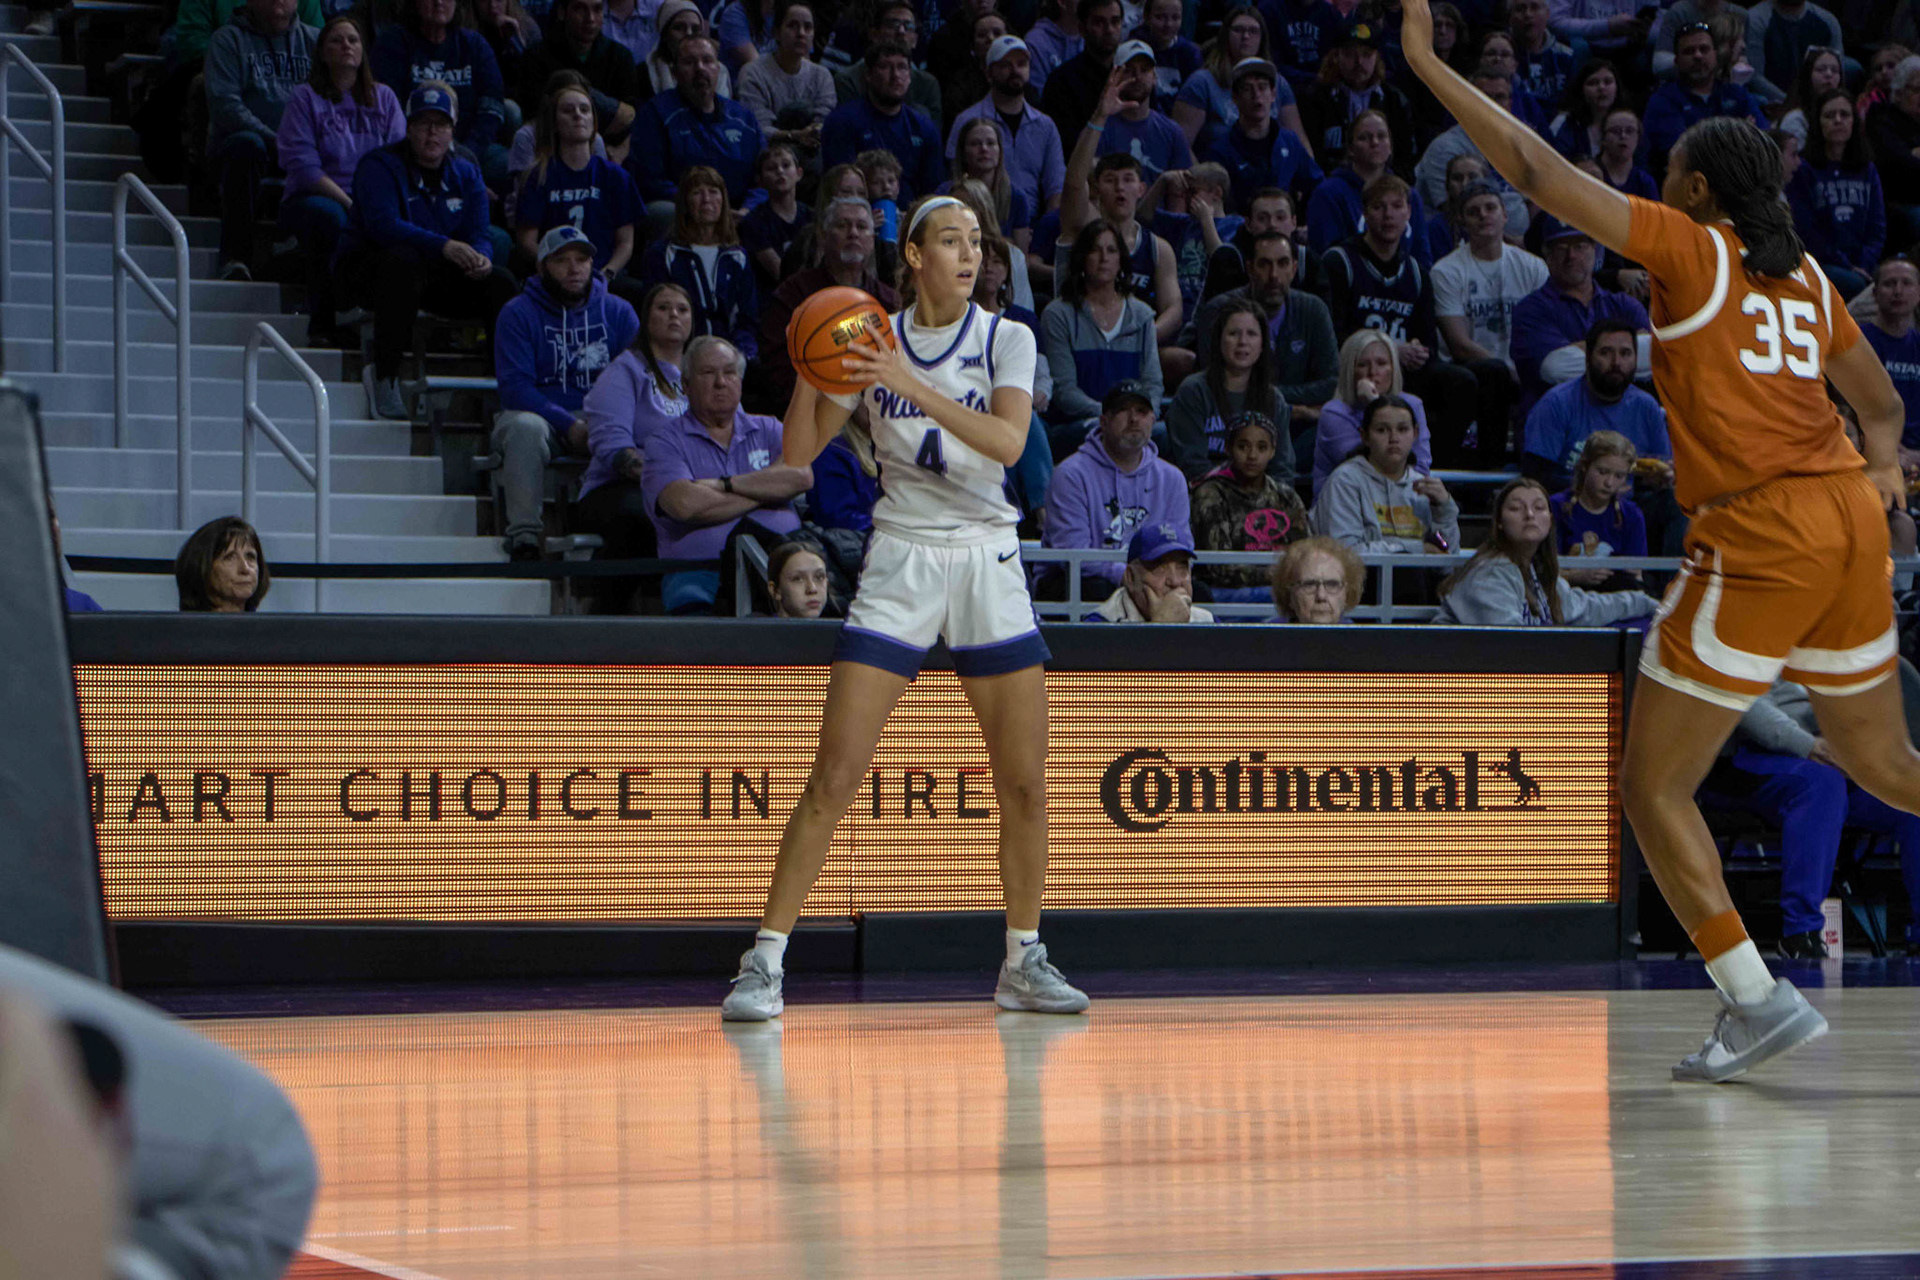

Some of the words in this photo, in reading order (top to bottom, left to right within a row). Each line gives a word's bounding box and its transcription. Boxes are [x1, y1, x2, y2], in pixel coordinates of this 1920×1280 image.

[1739, 292, 1821, 379] 35
[915, 427, 948, 474] 4
[90, 771, 290, 823] ART
[340, 769, 652, 823] CHOICE
[700, 768, 771, 820] IN
[1099, 747, 1479, 833] Continental
